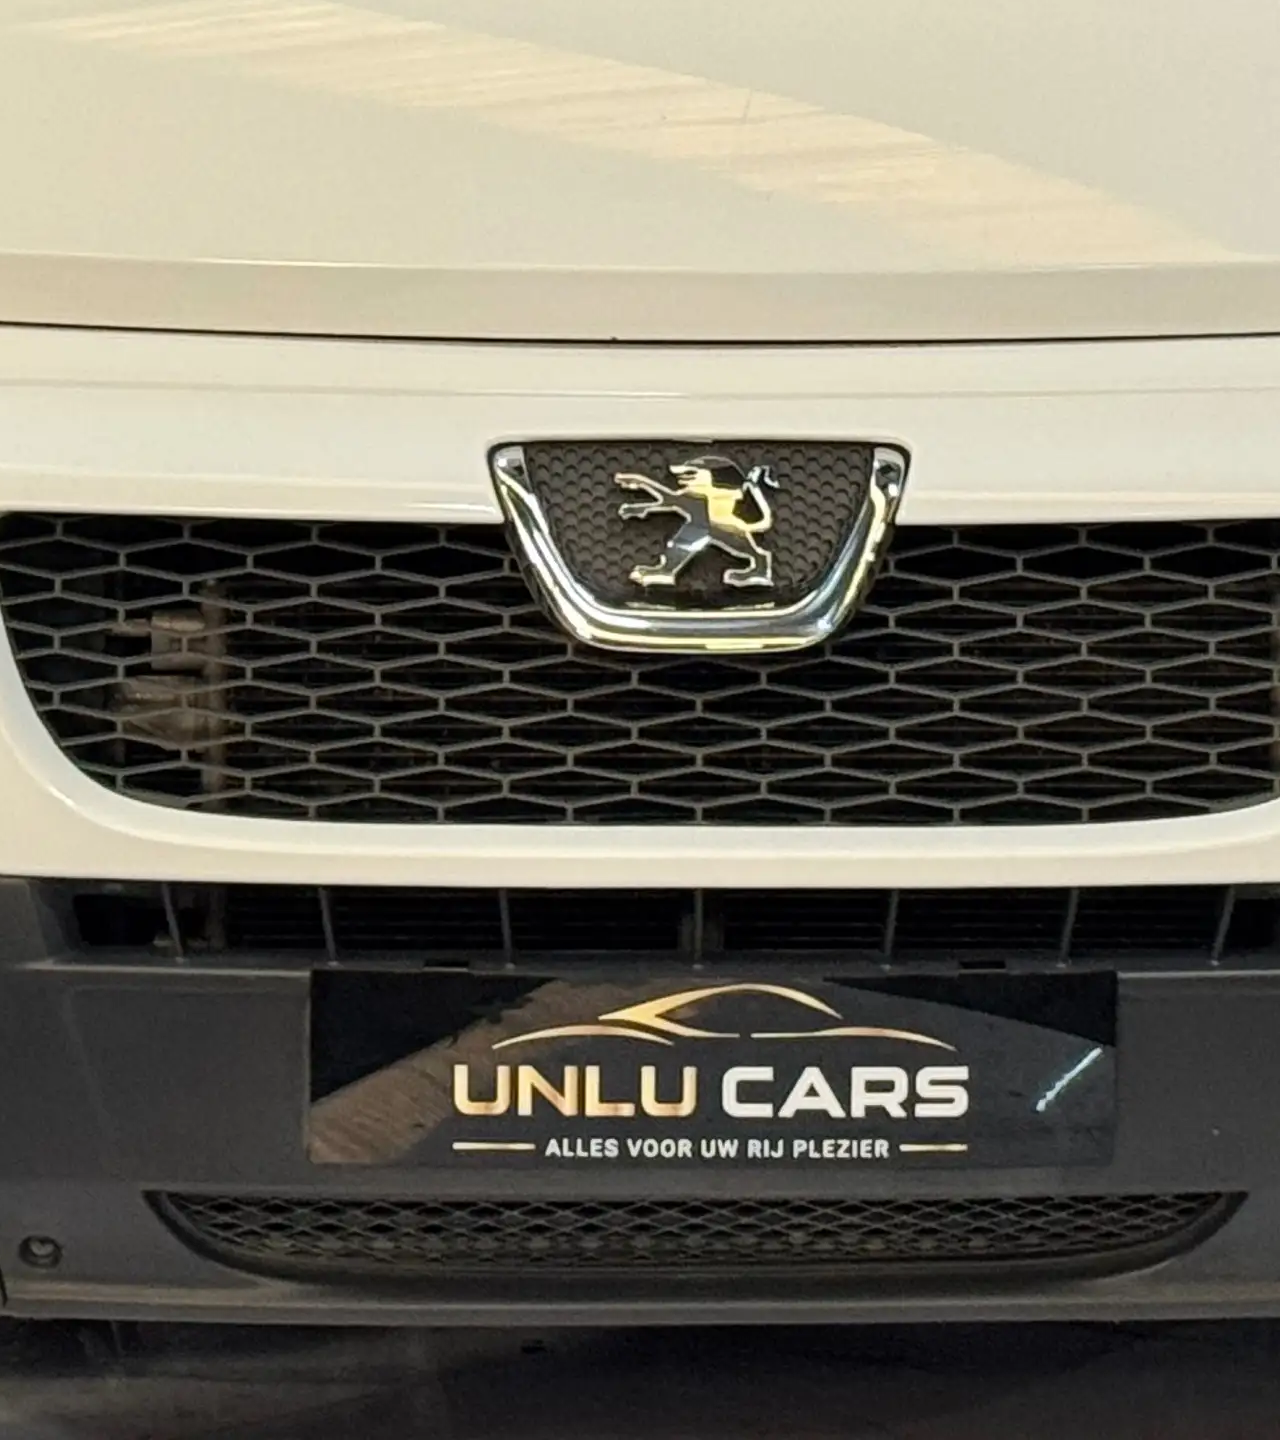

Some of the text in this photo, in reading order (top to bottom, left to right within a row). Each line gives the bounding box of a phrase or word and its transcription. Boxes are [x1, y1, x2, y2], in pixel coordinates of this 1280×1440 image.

[453, 1063, 970, 1119] UNLU CARS
[544, 1137, 891, 1159] ALLES VOOR UW RIJ PLEZIER
